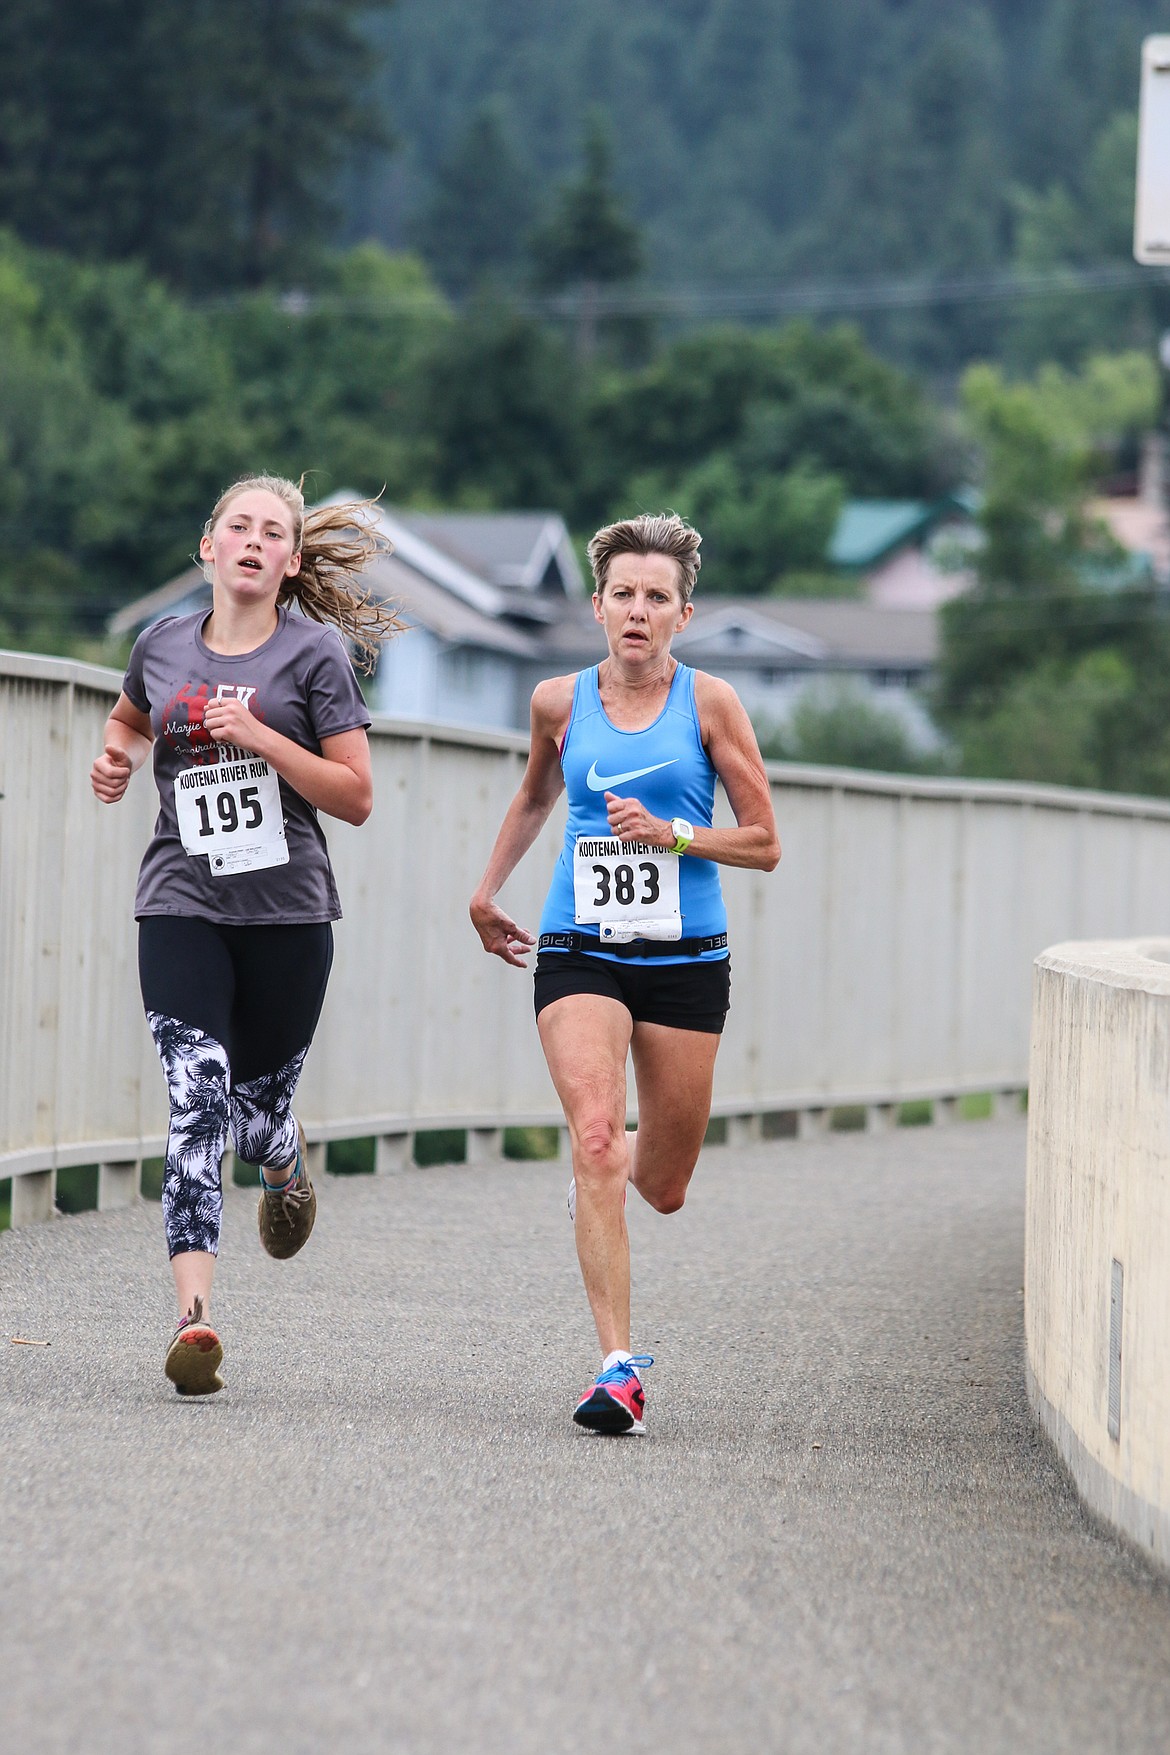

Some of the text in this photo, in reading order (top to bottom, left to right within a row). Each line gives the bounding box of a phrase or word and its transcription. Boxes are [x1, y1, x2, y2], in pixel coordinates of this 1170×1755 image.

[163, 721, 201, 736] Marjie
[180, 761, 269, 790] KOOTENAI RIVER RUN
[195, 786, 263, 837] 195
[579, 841, 620, 857] KOOTENAI
[622, 840, 649, 856] RIVER
[592, 862, 660, 907] 383
[539, 935, 574, 947] SPIB
